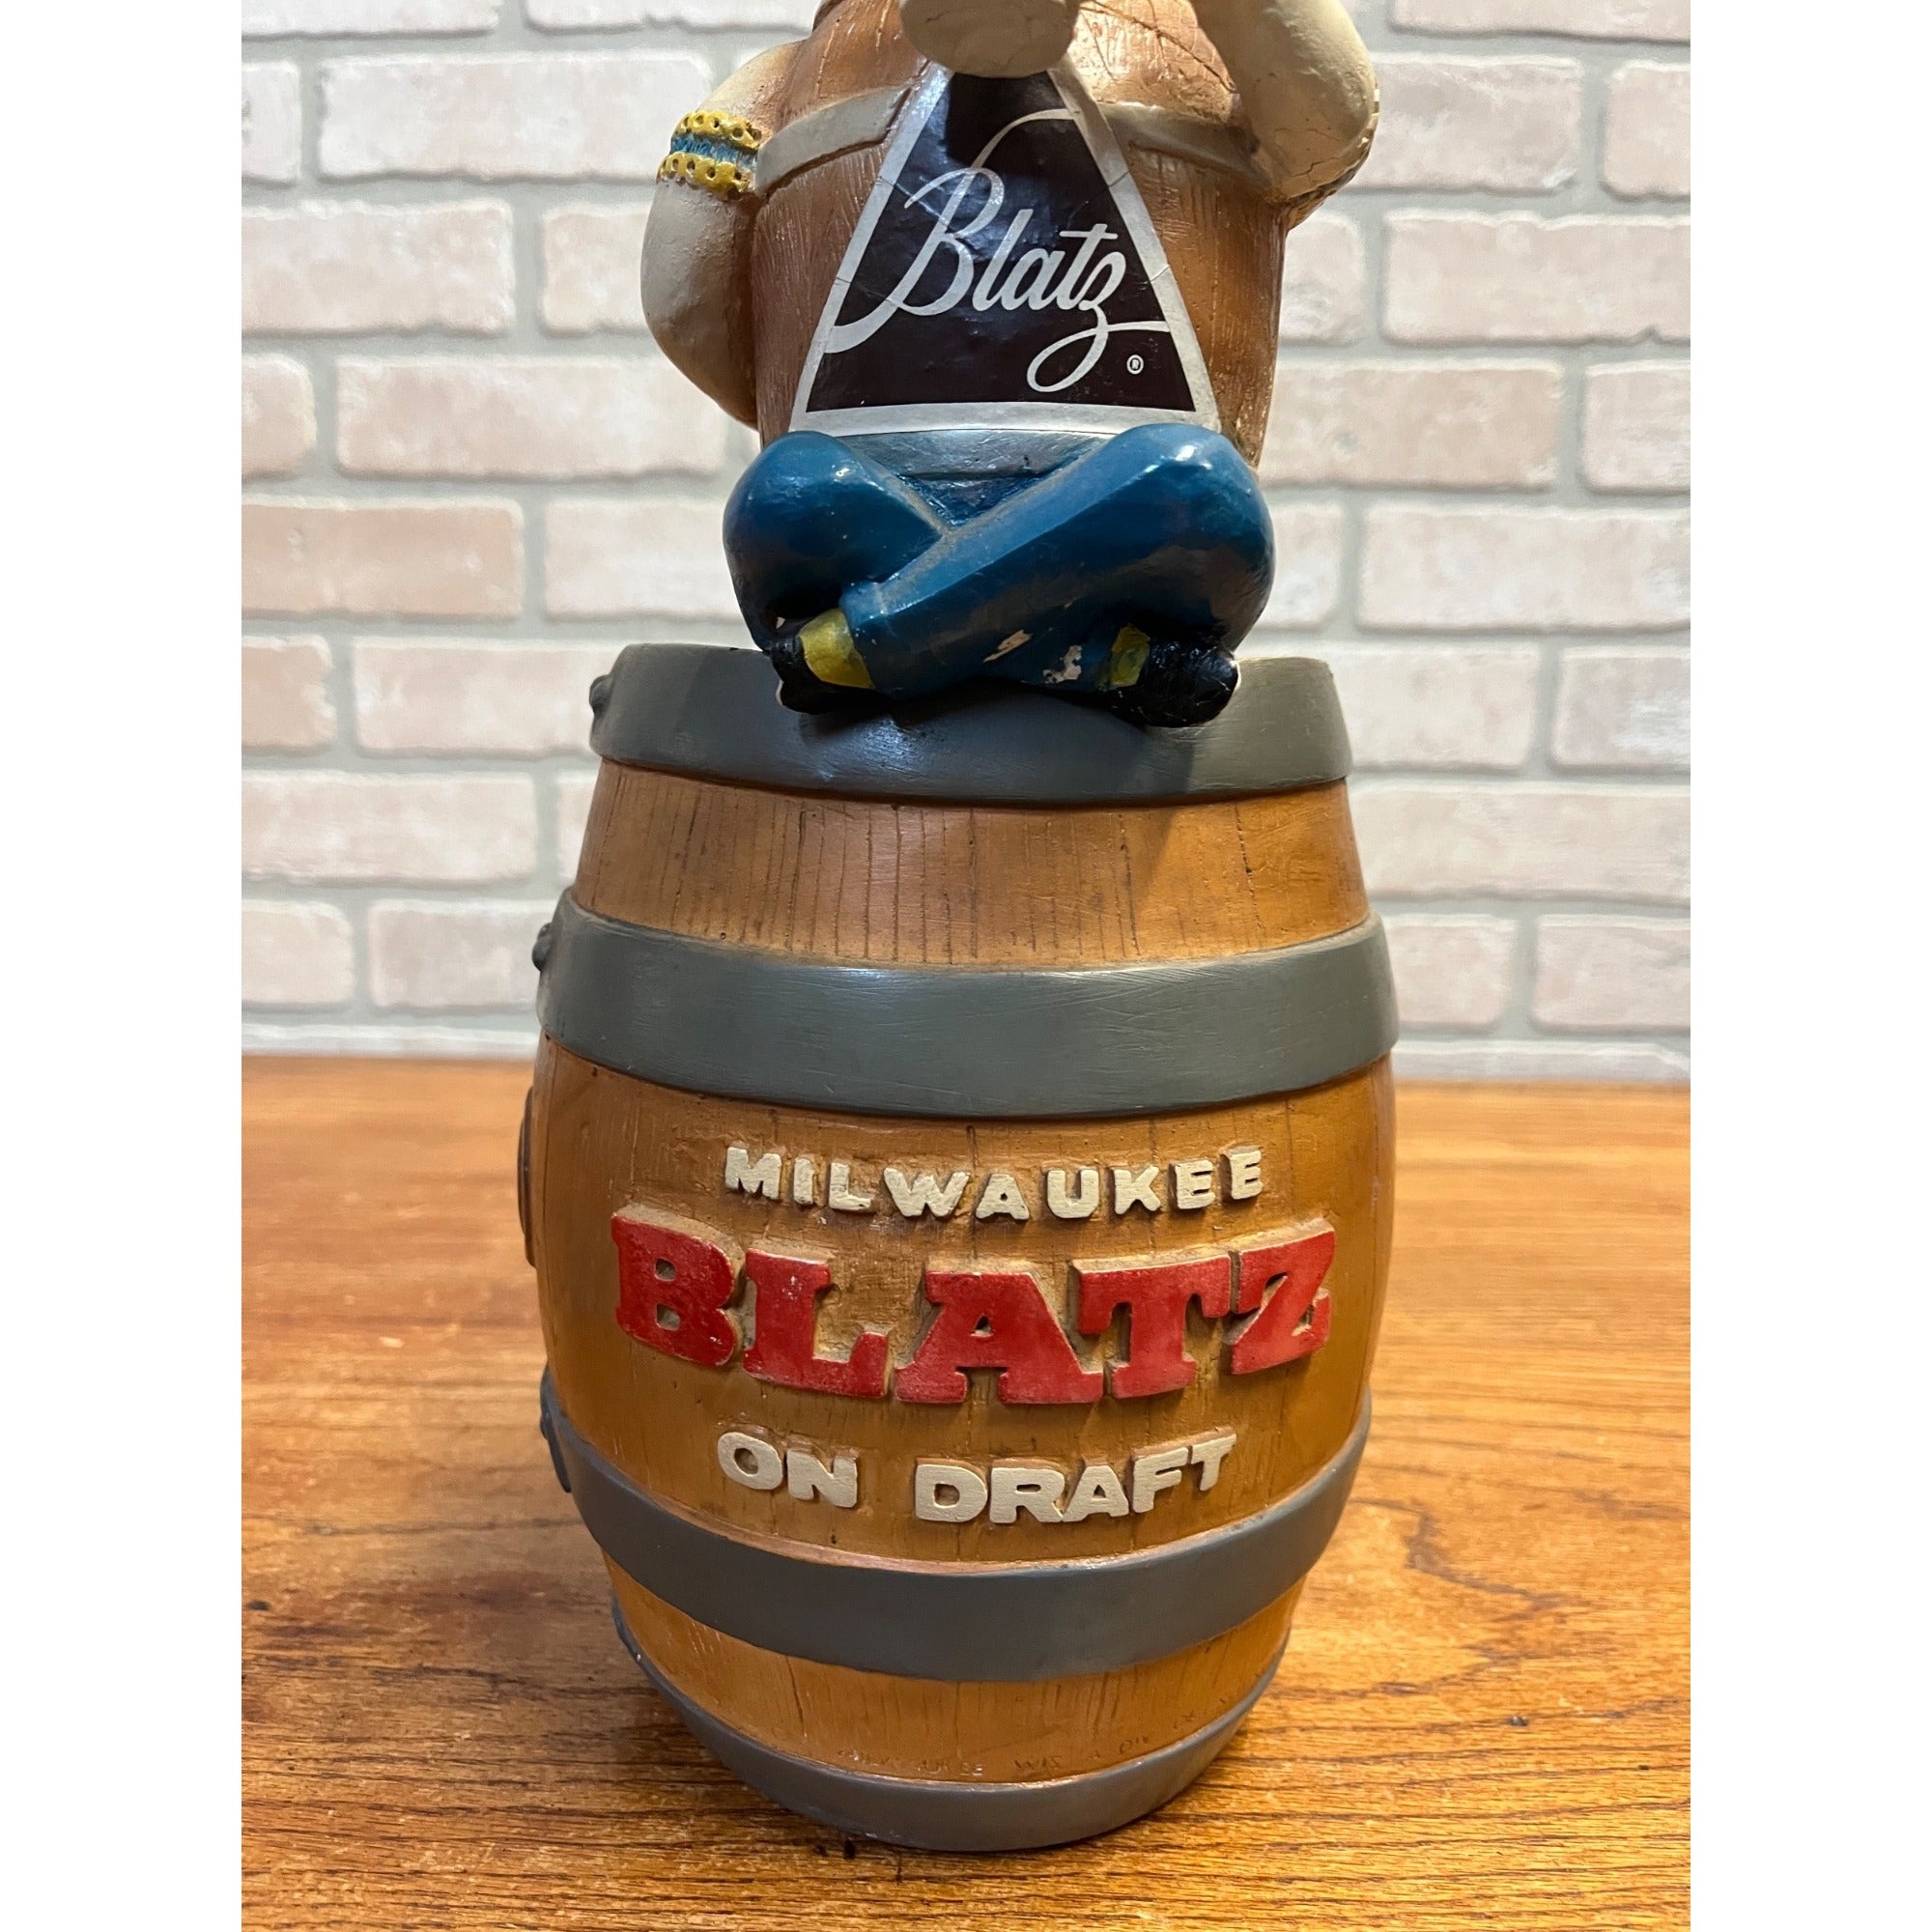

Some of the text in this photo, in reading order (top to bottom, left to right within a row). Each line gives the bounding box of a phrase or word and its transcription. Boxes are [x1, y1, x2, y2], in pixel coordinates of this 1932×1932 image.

[824, 108, 1171, 393] Blatz
[724, 1146, 1264, 1221] MILWAUKEE
[611, 1213, 1337, 1405] BLATZ
[717, 1430, 1237, 1524] ON DRAFT
